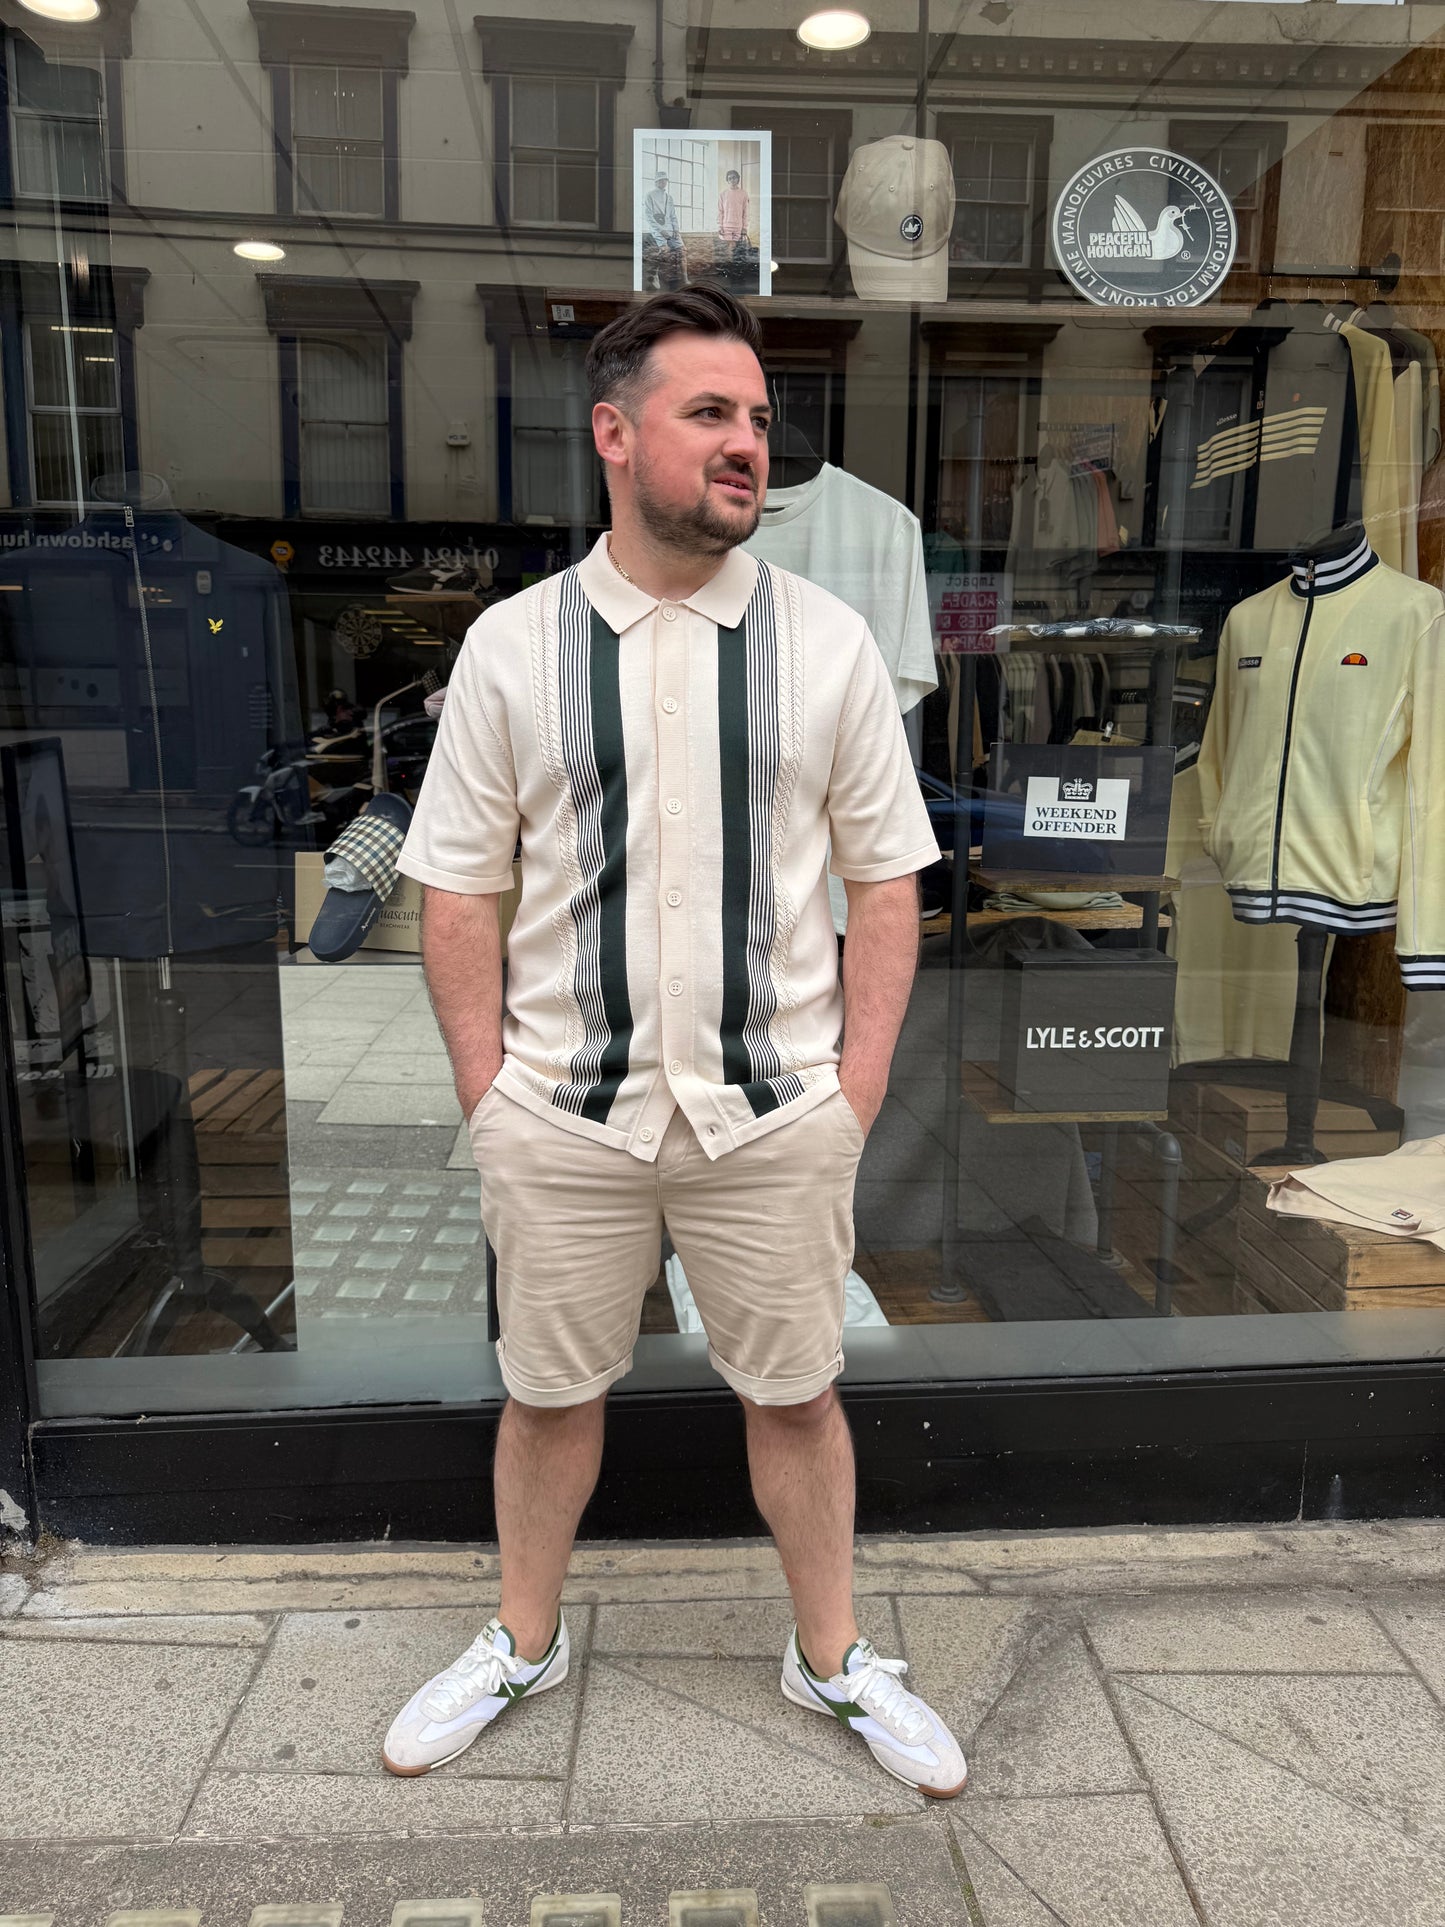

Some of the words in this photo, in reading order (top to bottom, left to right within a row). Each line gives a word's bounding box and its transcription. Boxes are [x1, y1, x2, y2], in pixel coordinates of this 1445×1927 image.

[1150, 156, 1217, 203] CIVILIAN
[1062, 156, 1134, 245] MANOEUVRES
[1089, 232, 1150, 245] PEACEFUL
[1197, 208, 1229, 286] UNIFORM
[1087, 246, 1150, 258] HOOLIGAN
[1067, 251, 1098, 287] LINE
[1164, 284, 1198, 306] FOR
[1036, 807, 1117, 820] WEEKEND
[1032, 820, 1117, 834] OFFENDER
